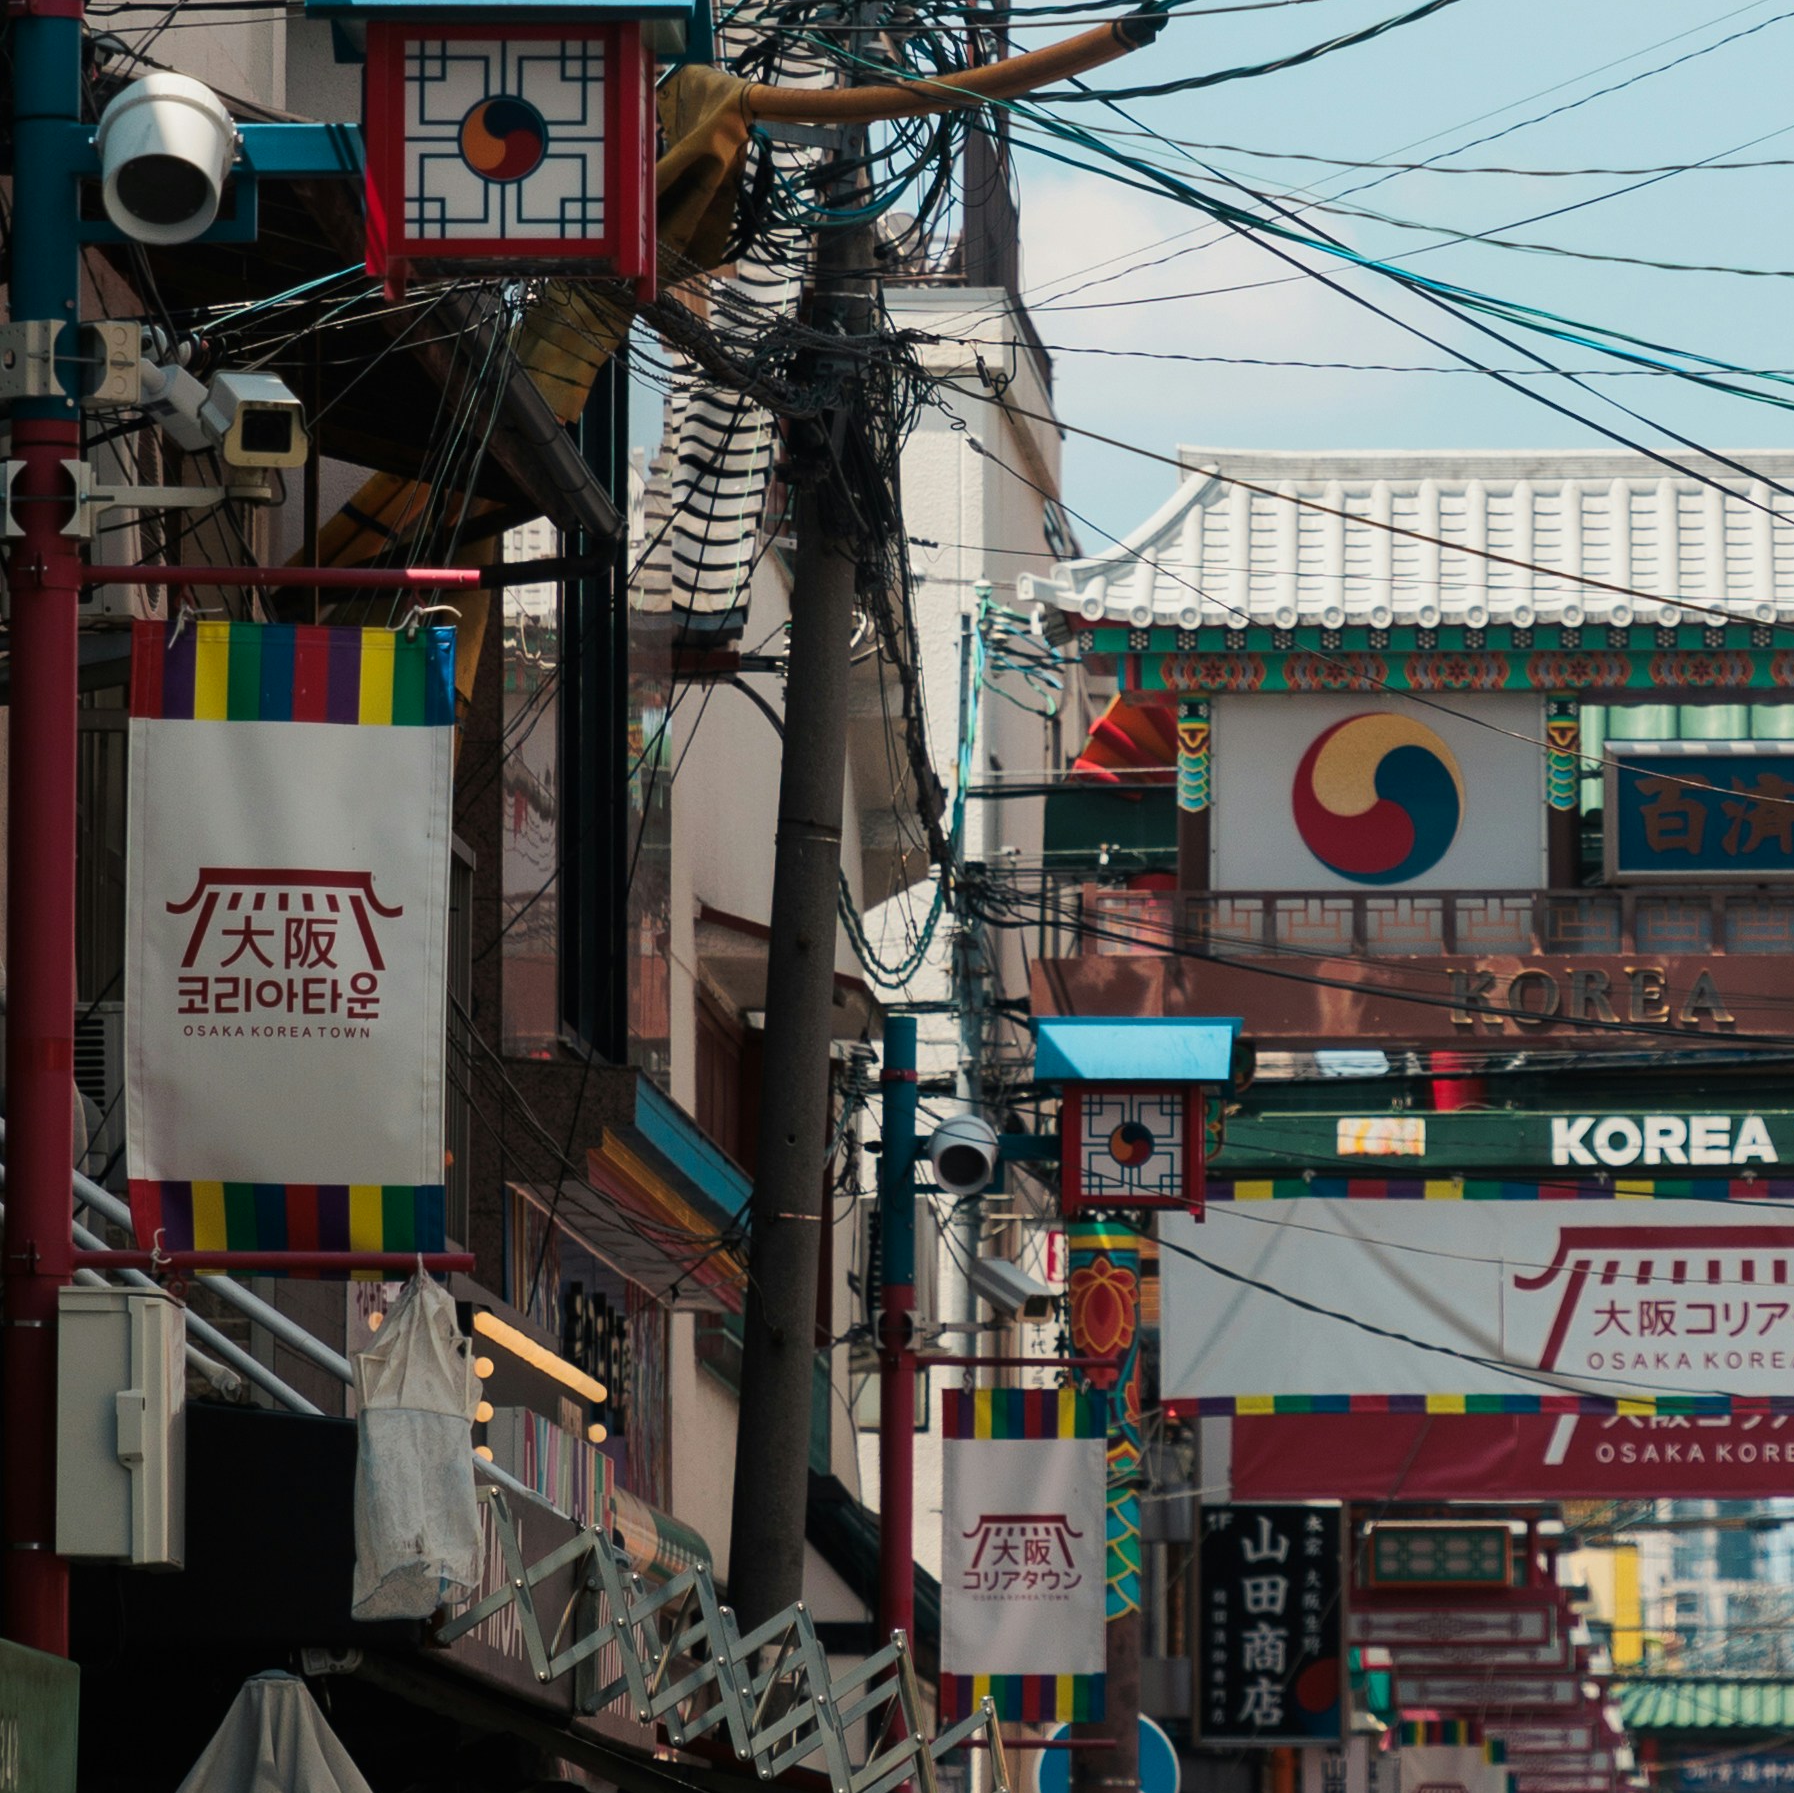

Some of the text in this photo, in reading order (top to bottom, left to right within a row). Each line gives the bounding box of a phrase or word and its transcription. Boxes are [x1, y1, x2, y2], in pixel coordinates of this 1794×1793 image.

[220, 915, 338, 969] 大阪
[178, 972, 380, 1019] 코리아타운
[1446, 965, 1736, 1025] KOREA
[183, 1025, 370, 1038] OSAKA KOREA TOWN
[1551, 1115, 1779, 1166] KOREA
[1587, 1351, 1692, 1370] OSAKA
[1595, 1443, 1705, 1463] OSAKA
[992, 1538, 1051, 1566] 大阪
[963, 1569, 1082, 1591] コリアタウン
[1238, 1514, 1290, 1726] 山田商店
